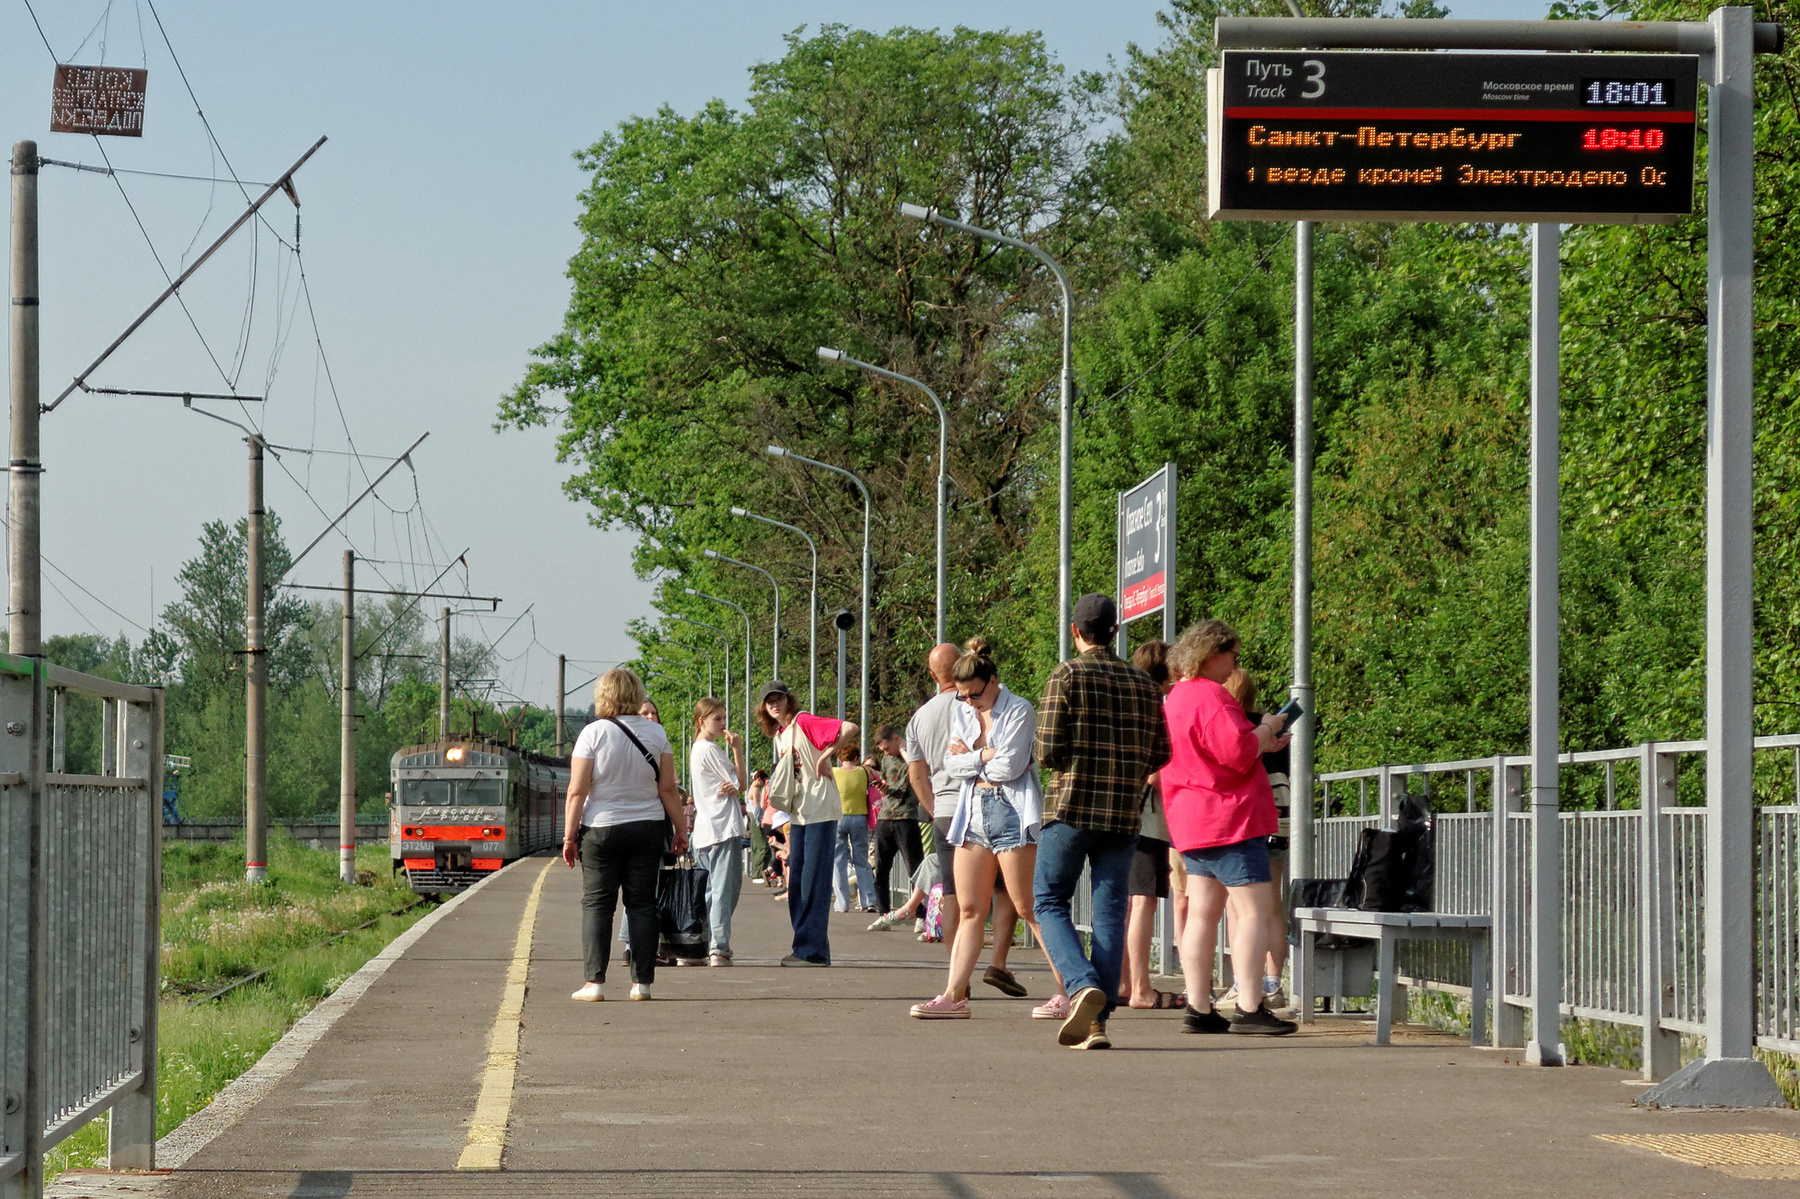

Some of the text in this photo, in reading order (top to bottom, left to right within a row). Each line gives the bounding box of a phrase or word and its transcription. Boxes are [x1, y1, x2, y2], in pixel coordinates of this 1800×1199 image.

[1246, 59, 1293, 81] Путь
[1301, 59, 1326, 99] 3
[1247, 84, 1287, 98] Track
[1482, 93, 1530, 101] Moscow time
[1483, 81, 1575, 92] Московское время
[1586, 81, 1667, 105] 18:01
[1249, 125, 1522, 150] Санкт-Петербург
[1583, 128, 1664, 150] 18:10
[1267, 166, 1346, 185] везде
[1458, 164, 1628, 187] Электродепо
[1154, 490, 1162, 563] 3
[482, 842, 499, 851] 077
